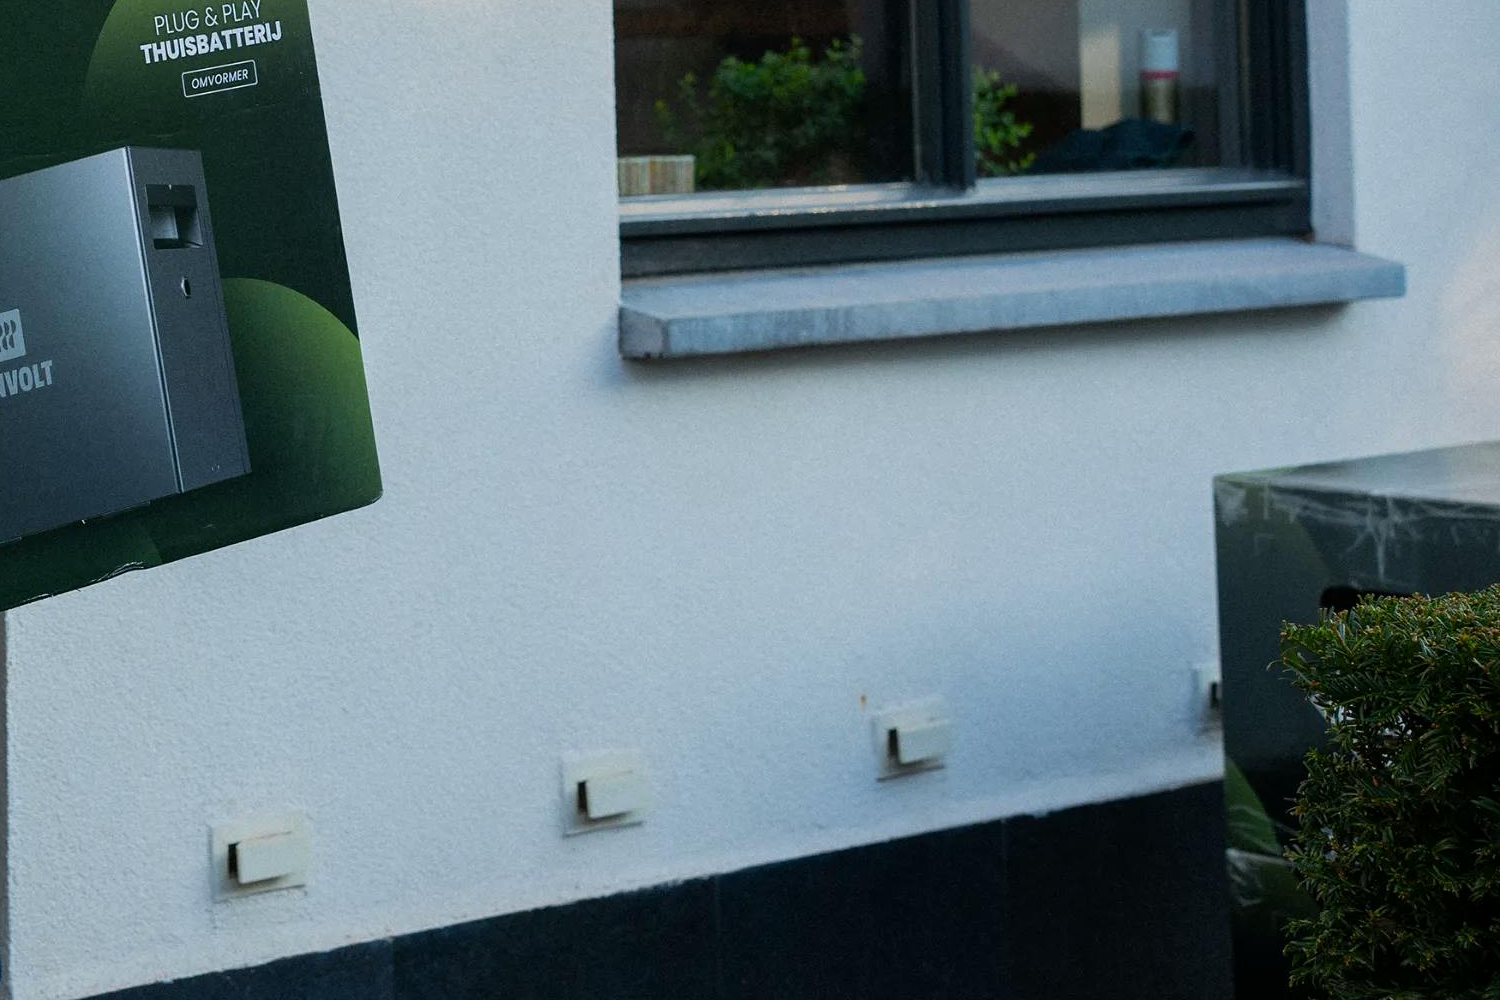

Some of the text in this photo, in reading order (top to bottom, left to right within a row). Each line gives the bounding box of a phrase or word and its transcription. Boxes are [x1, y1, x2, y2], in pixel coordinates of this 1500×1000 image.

[154, 10, 200, 36] PLUG
[204, 6, 219, 27] &
[140, 20, 282, 64] THUISBATTERIJ
[191, 68, 249, 90] OMVORMER
